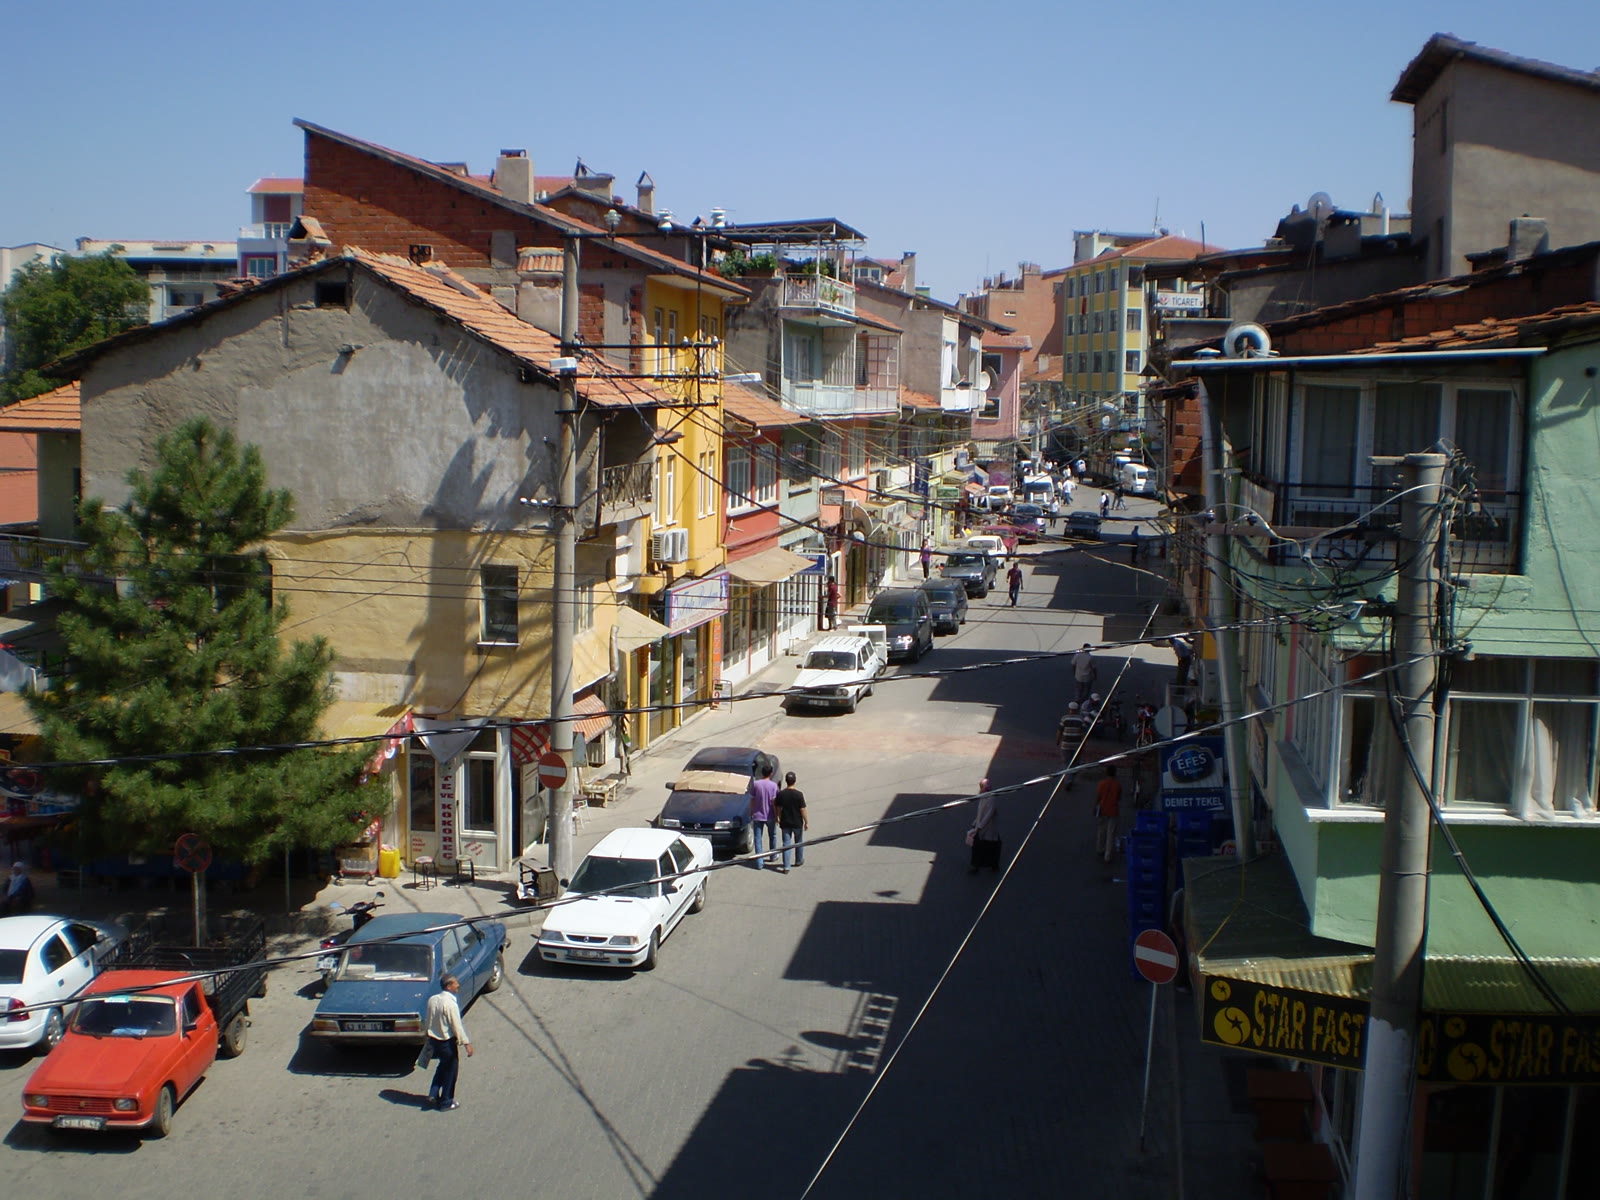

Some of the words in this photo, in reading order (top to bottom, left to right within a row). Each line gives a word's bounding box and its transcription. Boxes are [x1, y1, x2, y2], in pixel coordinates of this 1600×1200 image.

[1177, 753, 1207, 770] EFES
[1165, 797, 1193, 808] DEMET
[1196, 796, 1223, 807] TEKEL
[442, 803, 453, 860] KOKOREÇ
[1252, 989, 1306, 1050] STAR
[1312, 1006, 1365, 1058] FAST
[1488, 1018, 1554, 1080] STAR
